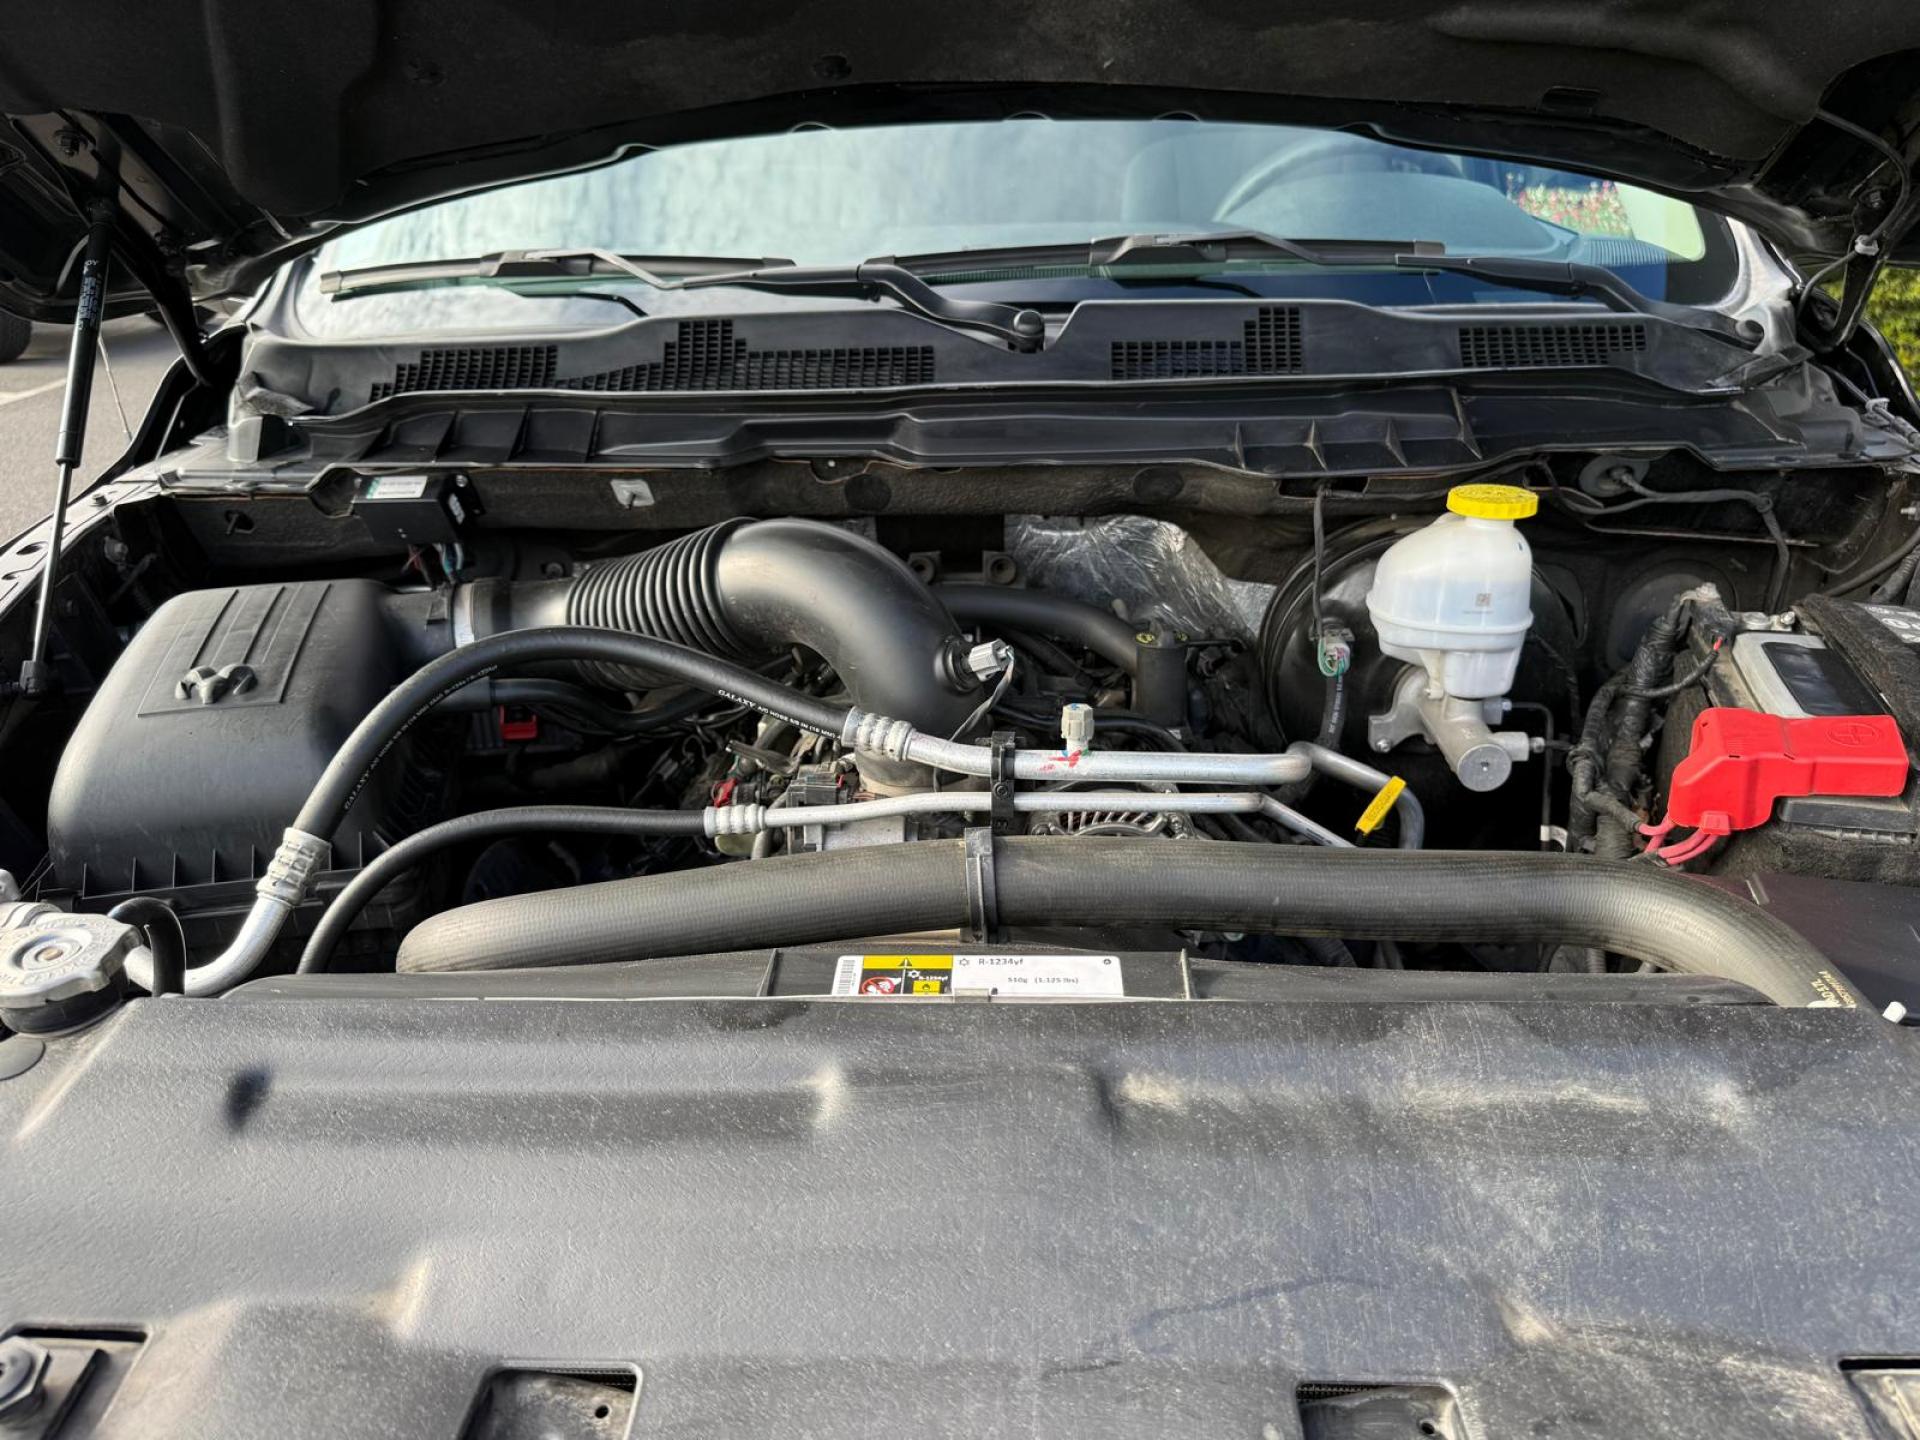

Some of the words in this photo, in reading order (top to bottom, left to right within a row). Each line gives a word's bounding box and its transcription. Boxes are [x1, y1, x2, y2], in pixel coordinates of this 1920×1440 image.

[718, 689, 756, 707] GALAXY
[770, 710, 788, 722] HOSE
[978, 958, 1024, 966] R-1234yf
